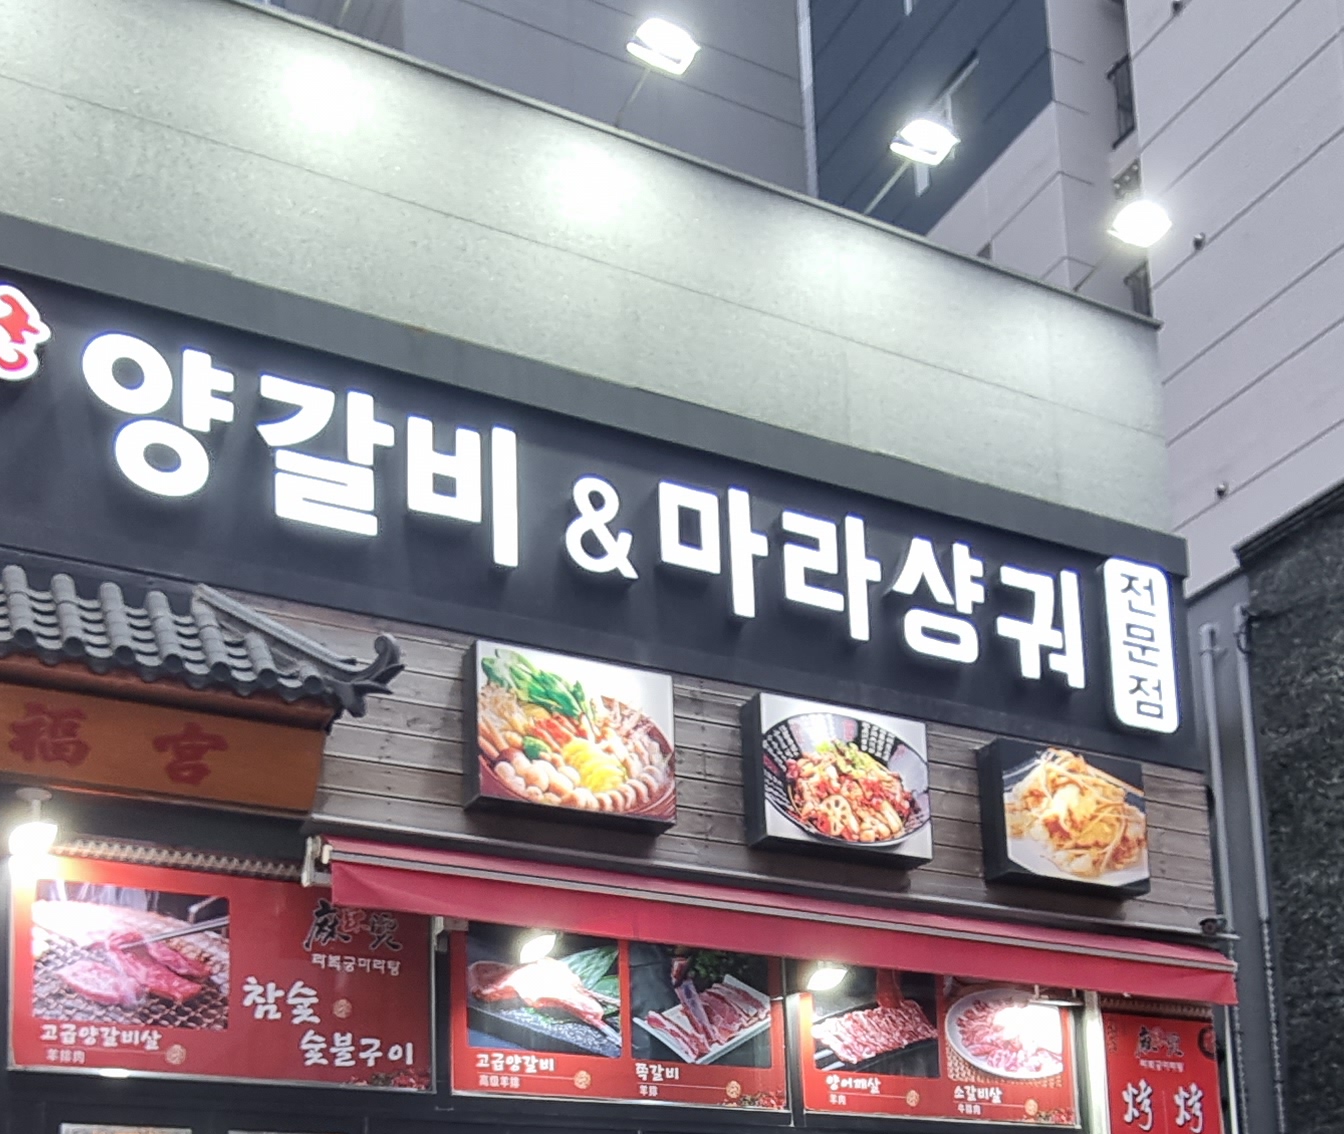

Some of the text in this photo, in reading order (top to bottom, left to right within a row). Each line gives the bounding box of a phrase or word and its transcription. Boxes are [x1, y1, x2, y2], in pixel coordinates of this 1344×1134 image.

[80, 332, 1086, 690] 양갈비 & 마라샹궈
[1119, 572, 1166, 722] 전문점
[243, 976, 321, 1024] 참숯
[40, 1023, 162, 1051] 고급양갈비살
[298, 1030, 413, 1067] 숯불구이
[475, 1053, 555, 1073] 고급양갈비
[635, 1063, 679, 1081] 쪽갈비
[826, 1075, 880, 1094] 양어깨살
[954, 1085, 1003, 1104] 소갈비살
